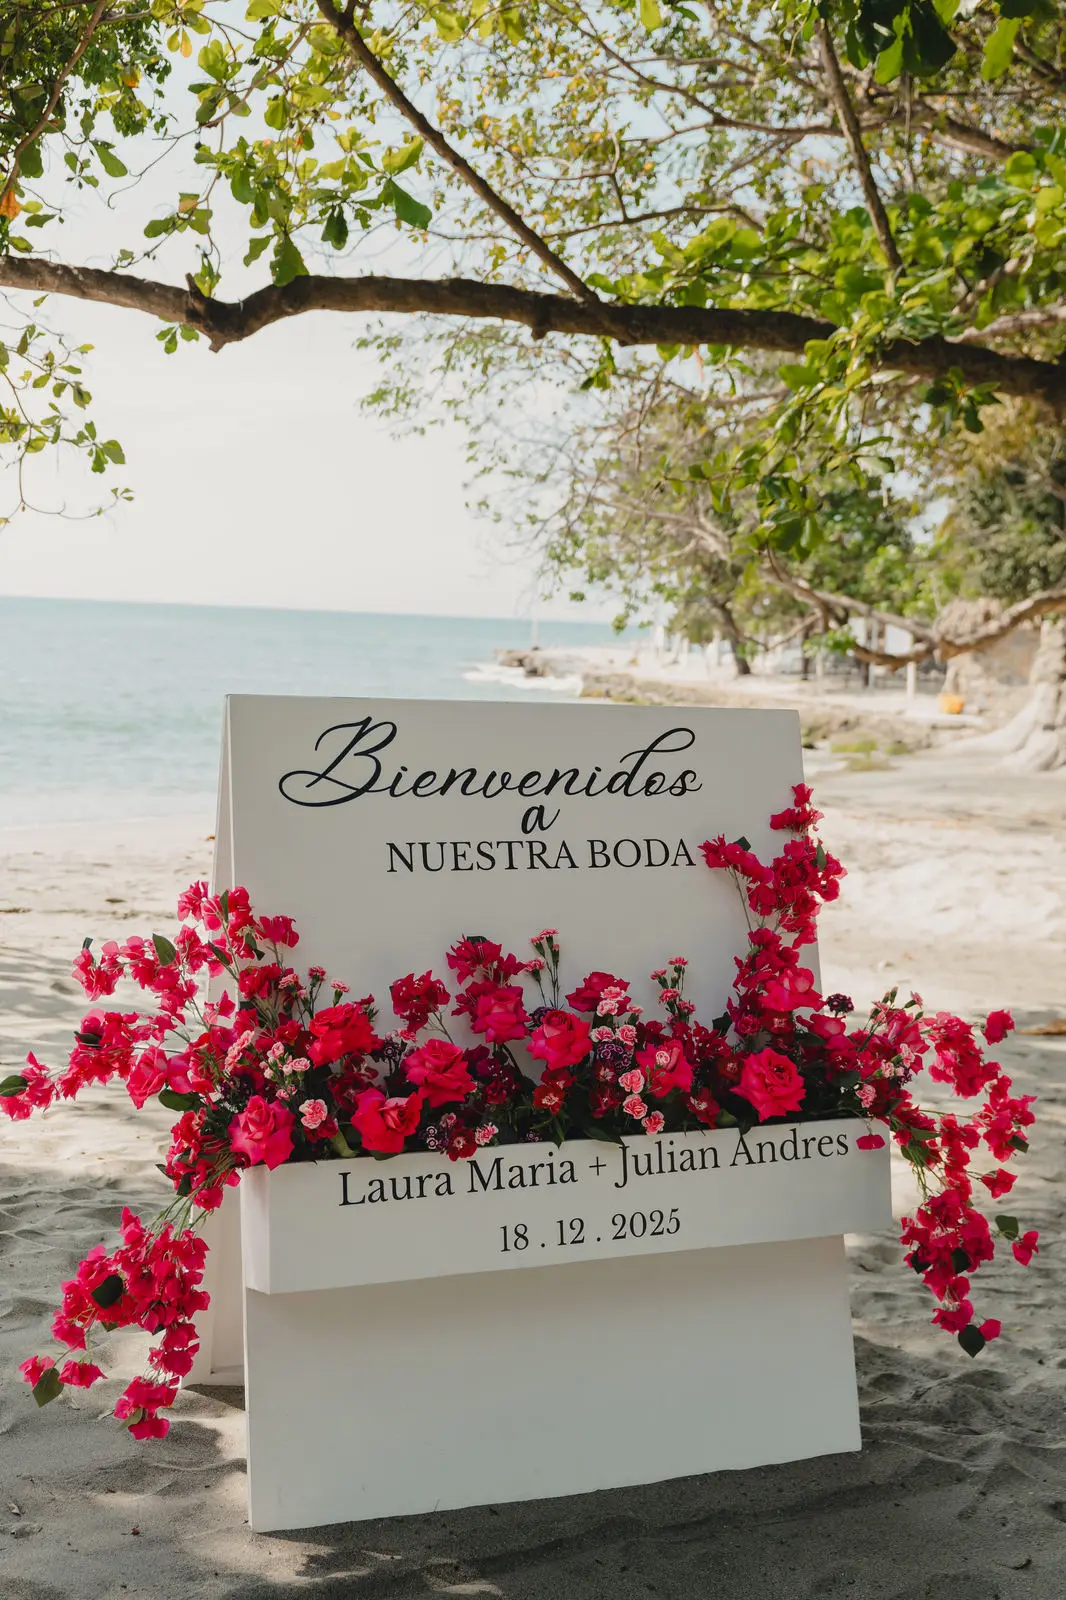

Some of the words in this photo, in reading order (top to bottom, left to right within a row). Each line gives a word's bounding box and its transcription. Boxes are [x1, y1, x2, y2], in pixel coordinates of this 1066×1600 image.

[278, 715, 703, 808] Bienvenidos
[521, 804, 561, 835] a
[386, 839, 579, 873] NUESTRA
[587, 838, 697, 869] BODA
[338, 1170, 455, 1206] Laura
[466, 1150, 578, 1193] Maria
[588, 1156, 607, 1176] +
[614, 1139, 721, 1189] Julian
[729, 1127, 850, 1167] Andres
